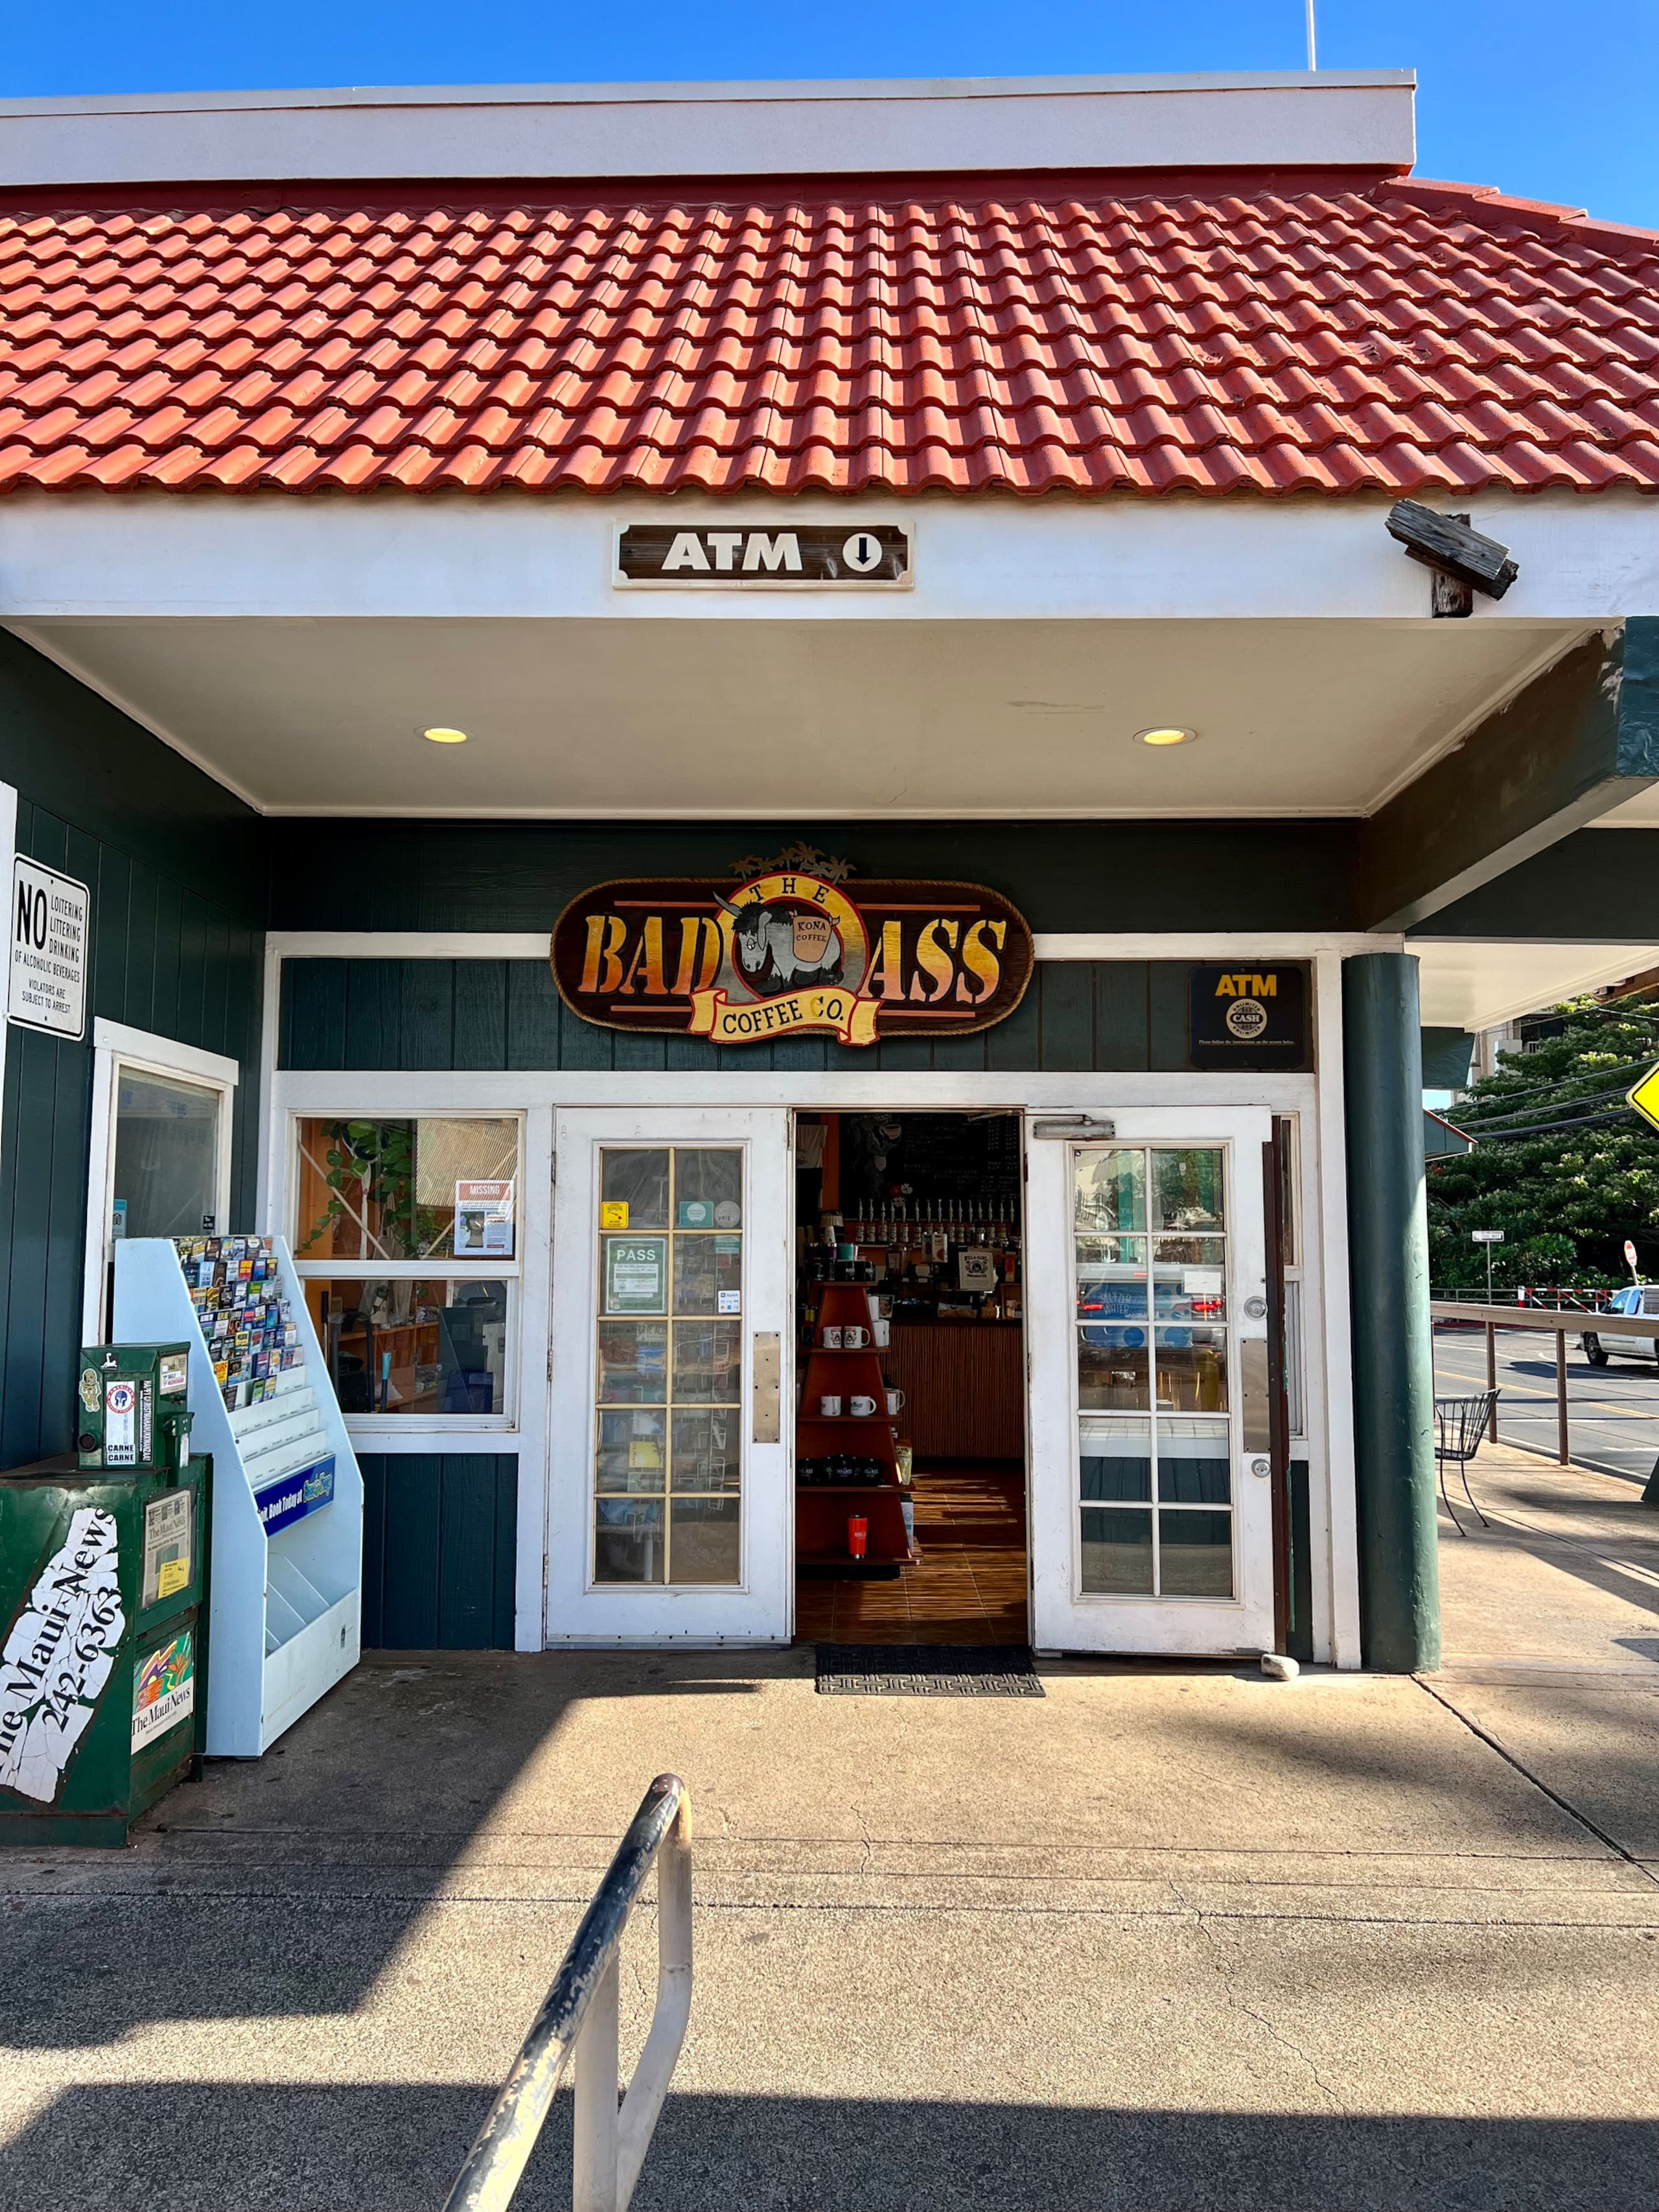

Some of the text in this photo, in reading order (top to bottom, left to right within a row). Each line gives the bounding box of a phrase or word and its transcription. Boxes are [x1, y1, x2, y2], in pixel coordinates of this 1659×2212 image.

[660, 532, 803, 571] ATM
[749, 876, 830, 905] THE
[16, 879, 47, 950] NO
[51, 894, 82, 922] LOITERING
[49, 916, 80, 942] LITTERING
[796, 933, 828, 943] COFFEE
[797, 921, 827, 932] KONA
[49, 938, 79, 963] DRINKING
[578, 915, 1008, 1004] BAD ASS
[15, 949, 80, 983] OF ALCOHOLIC BEVERAGES
[29, 978, 66, 999] VIOLATORS ARE
[1214, 974, 1277, 996] ATM
[21, 990, 71, 1014] SUBJECT TO ARREST
[1233, 1001, 1261, 1012] UNLIMITED
[723, 995, 845, 1035] COFFEE CO.
[1232, 1014, 1260, 1023] CASH
[1233, 1025, 1261, 1036] UNLIMITED
[469, 1185, 500, 1196] MISSING
[616, 1249, 656, 1261] PASS
[1102, 1292, 1131, 1304] SELTZER
[1103, 1303, 1130, 1315] WATER
[269, 1499, 283, 1520] Book
[282, 1493, 297, 1513] Today
[297, 1489, 303, 1505] at
[149, 1528, 160, 1540] The
[5, 1604, 72, 1704] Maui
[51, 1508, 115, 1601] News
[41, 1586, 123, 1734] 242-6363
[131, 1716, 148, 1736] The
[148, 1697, 170, 1725] Maui
[170, 1686, 191, 1710] News
